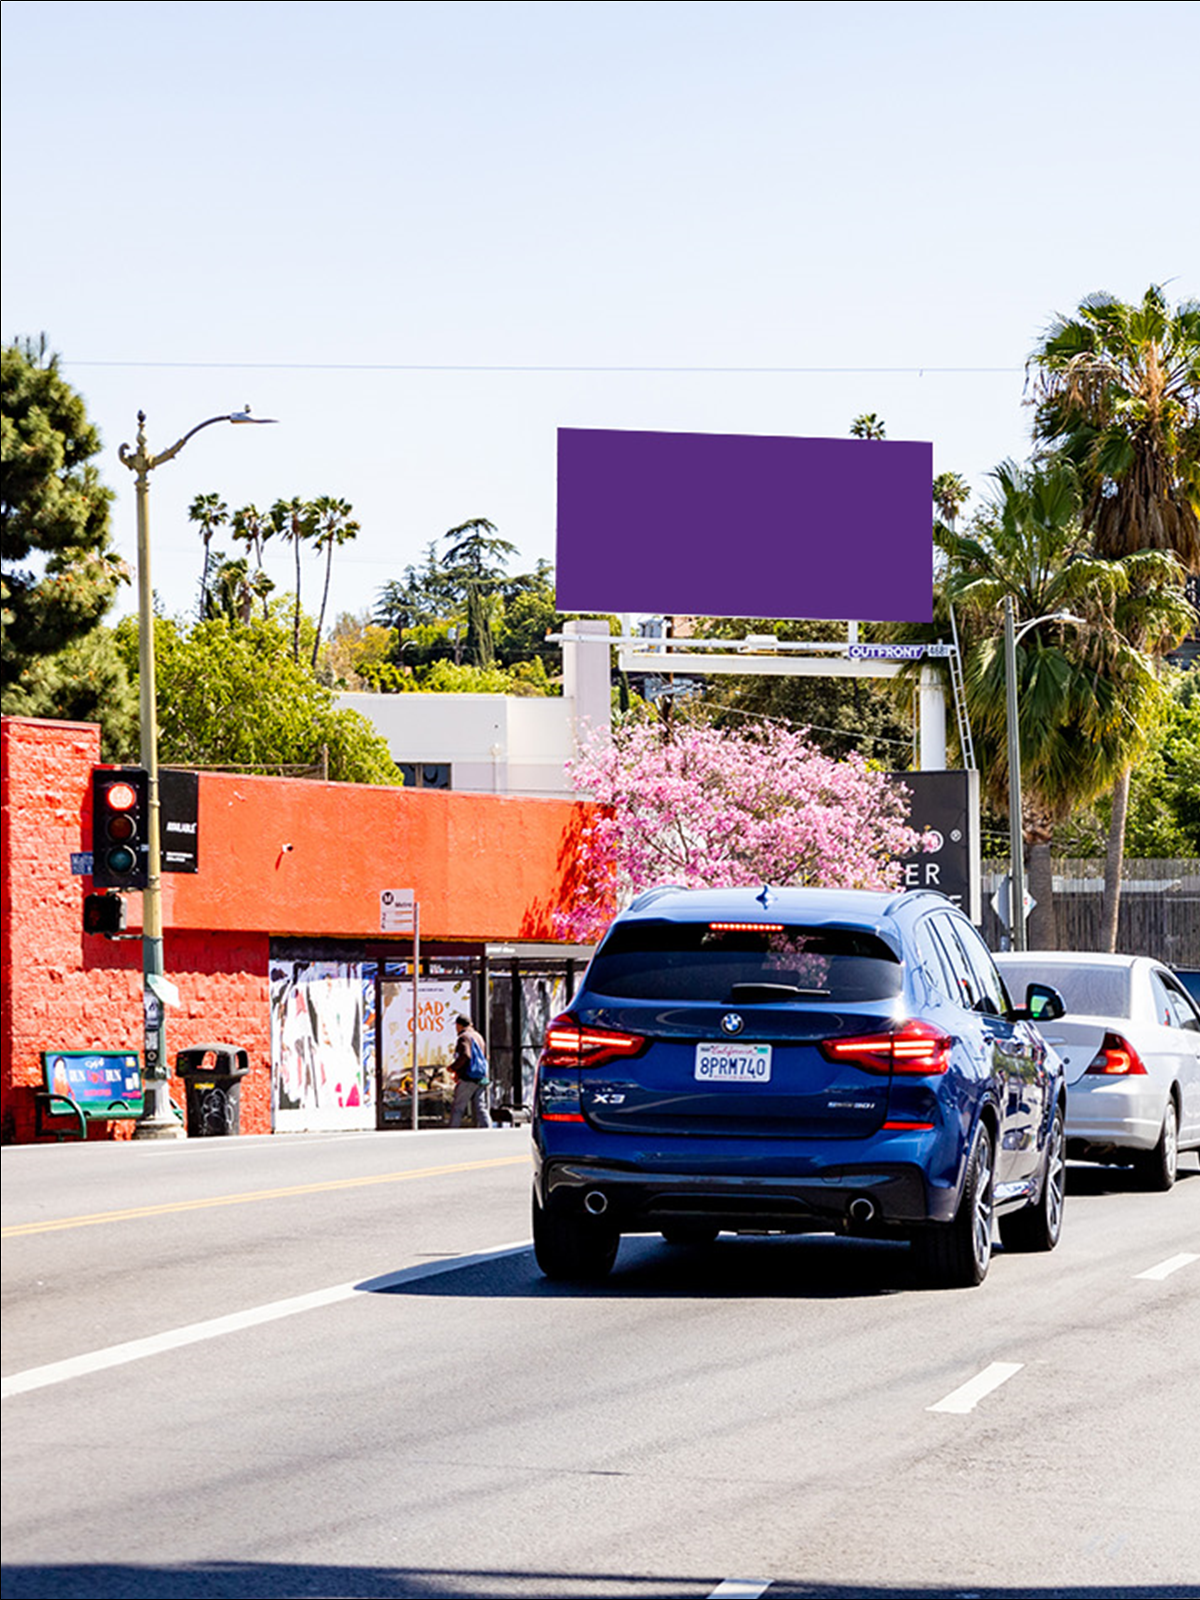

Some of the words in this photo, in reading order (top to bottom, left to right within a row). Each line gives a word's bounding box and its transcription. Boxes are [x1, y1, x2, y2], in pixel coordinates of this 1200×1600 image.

[851, 646, 922, 657] OUTFRONT
[700, 1057, 766, 1076] 8PRM740
[592, 1094, 626, 1104] X3
